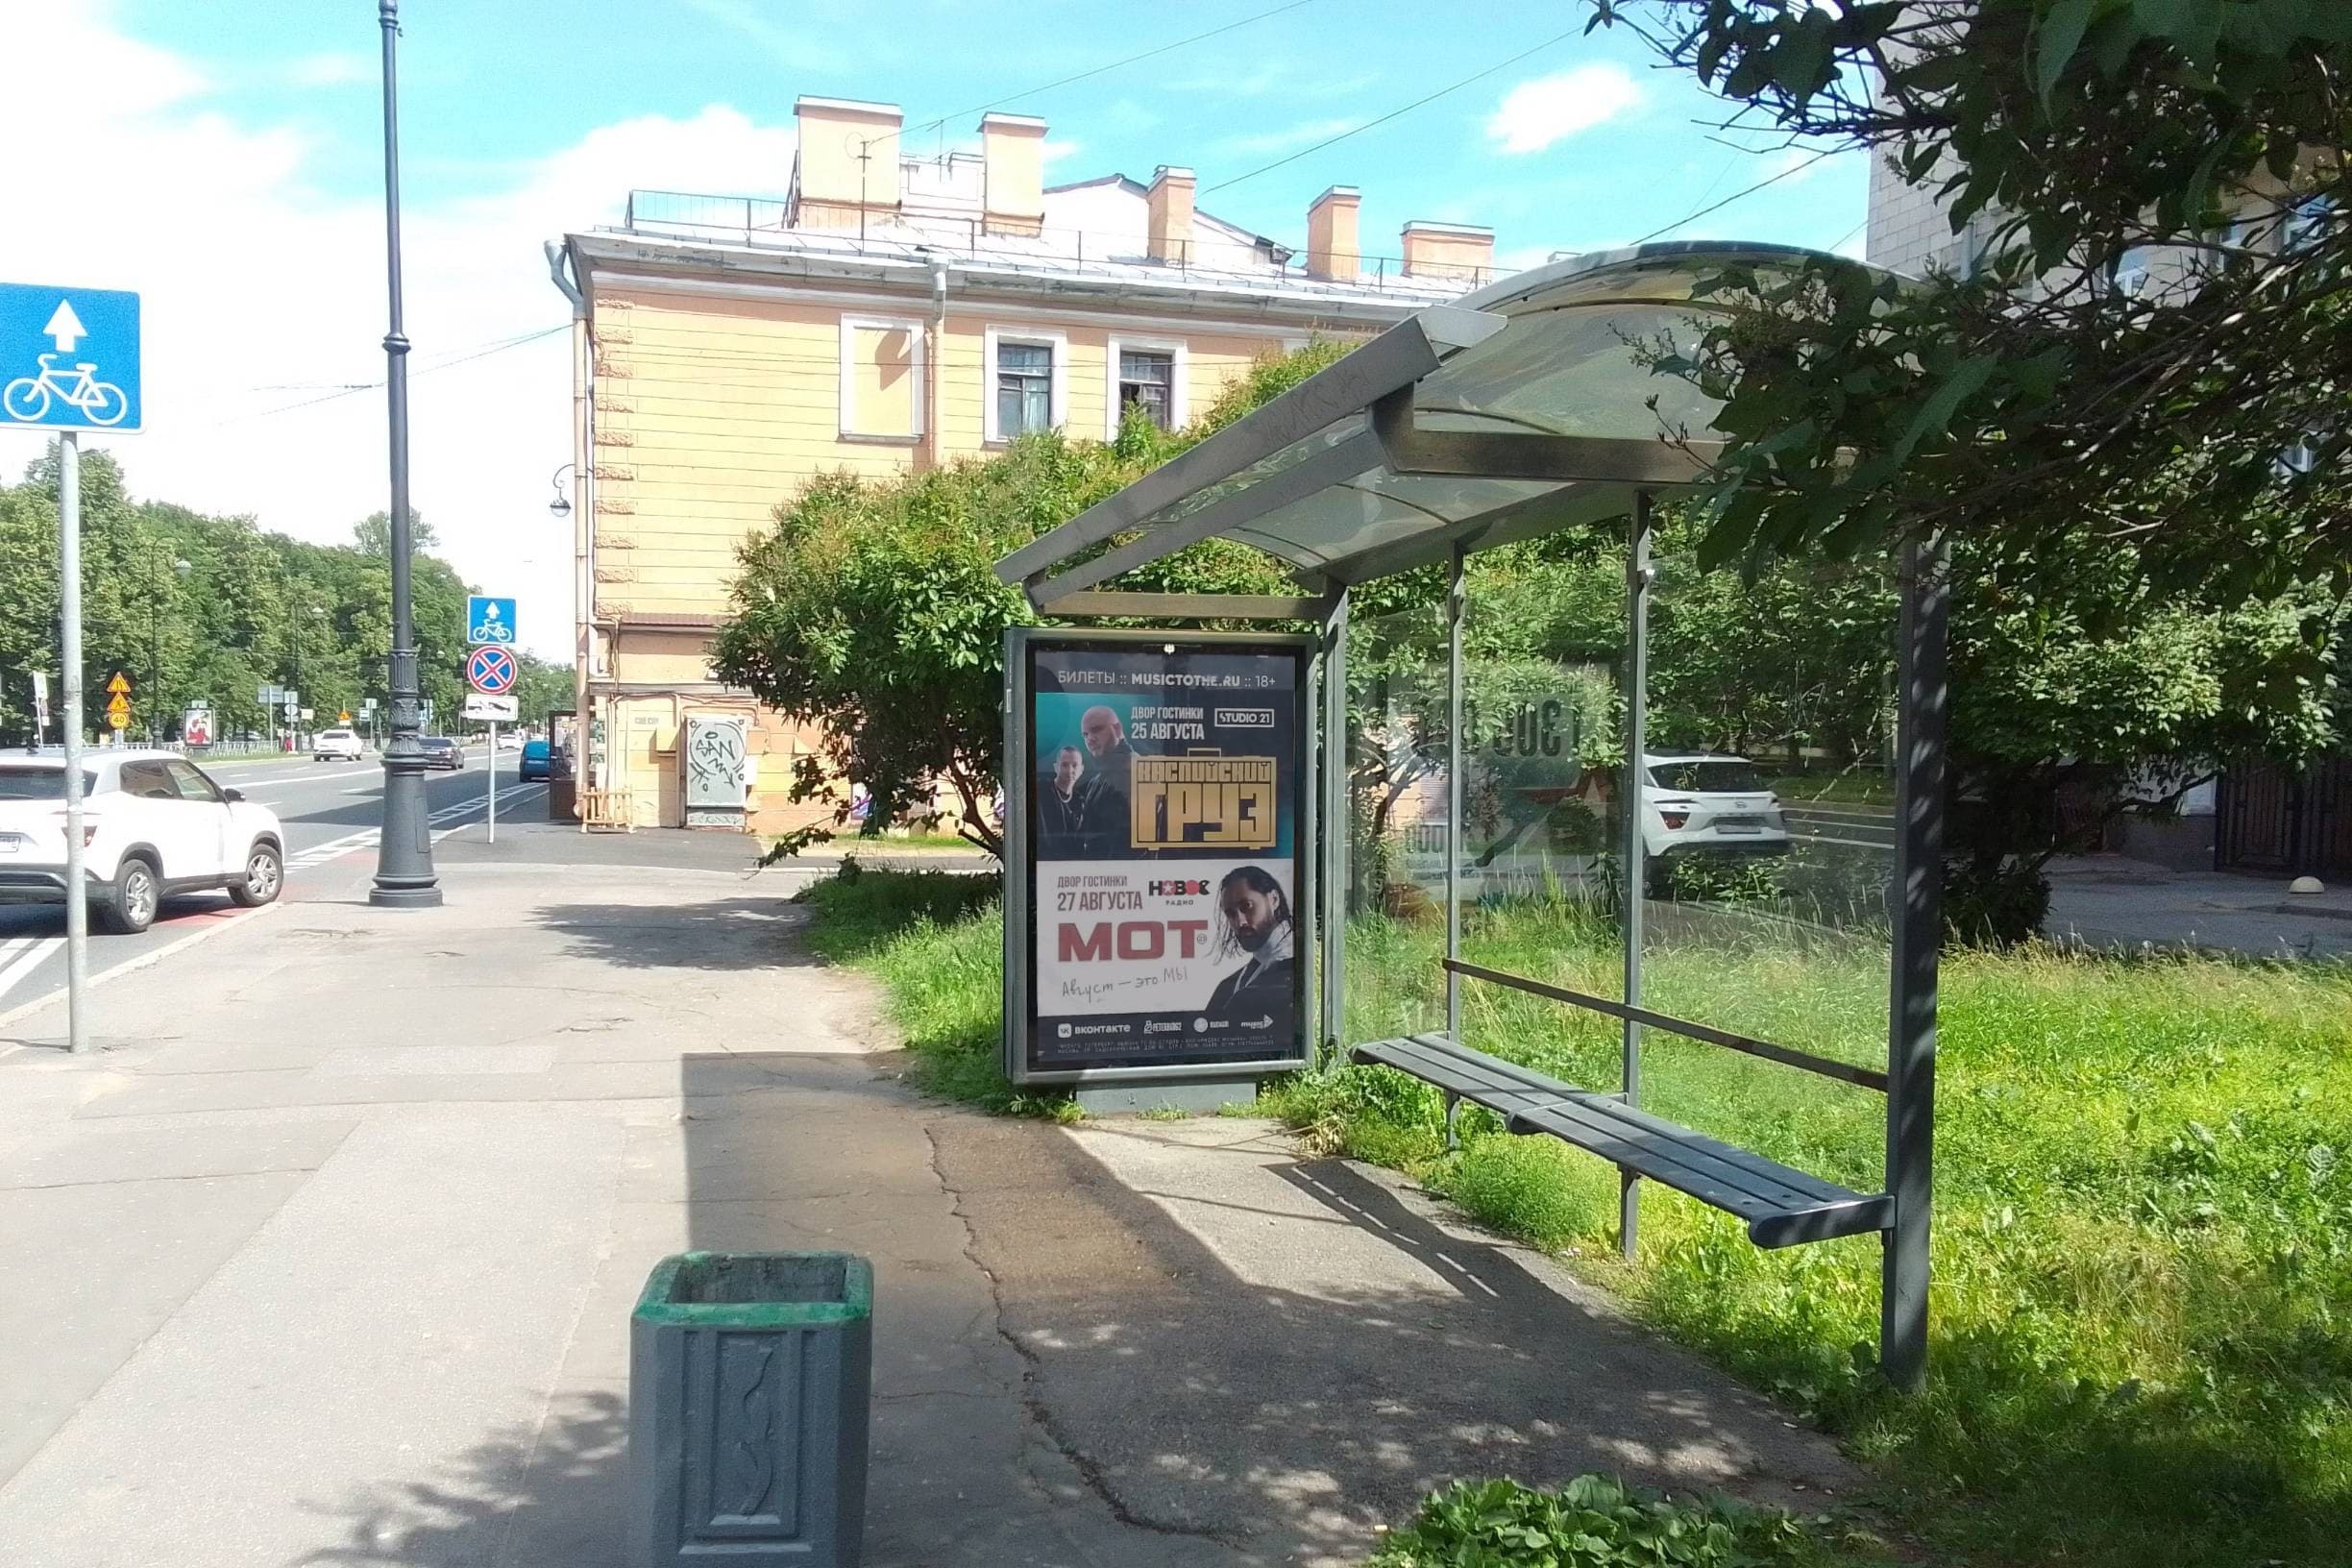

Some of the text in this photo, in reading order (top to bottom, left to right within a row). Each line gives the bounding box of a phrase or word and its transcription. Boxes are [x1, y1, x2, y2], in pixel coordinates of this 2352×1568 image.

[1058, 670, 1115, 684] БИЛЕТЫ
[1131, 673, 1240, 687] MUSICTOTHE.RU
[1255, 674, 1276, 688] 18+
[1130, 706, 1204, 720] ДВОР ГОСТИНКИ
[1219, 712, 1270, 723] STUDIO 21
[1131, 722, 1206, 740] 25 АВГУСТА
[1138, 761, 1271, 782] КАСПИЙСКИЙ
[1138, 783, 1270, 842] ГРУЗ
[1057, 875, 1128, 888] ДВОР ГОСТИНКИ
[1057, 891, 1143, 911] 27 АВГУСТА
[1058, 919, 1209, 962] МОТ
[1062, 978, 1114, 1004] Август
[1135, 976, 1159, 989] это
[1164, 966, 1188, 983] МЫ
